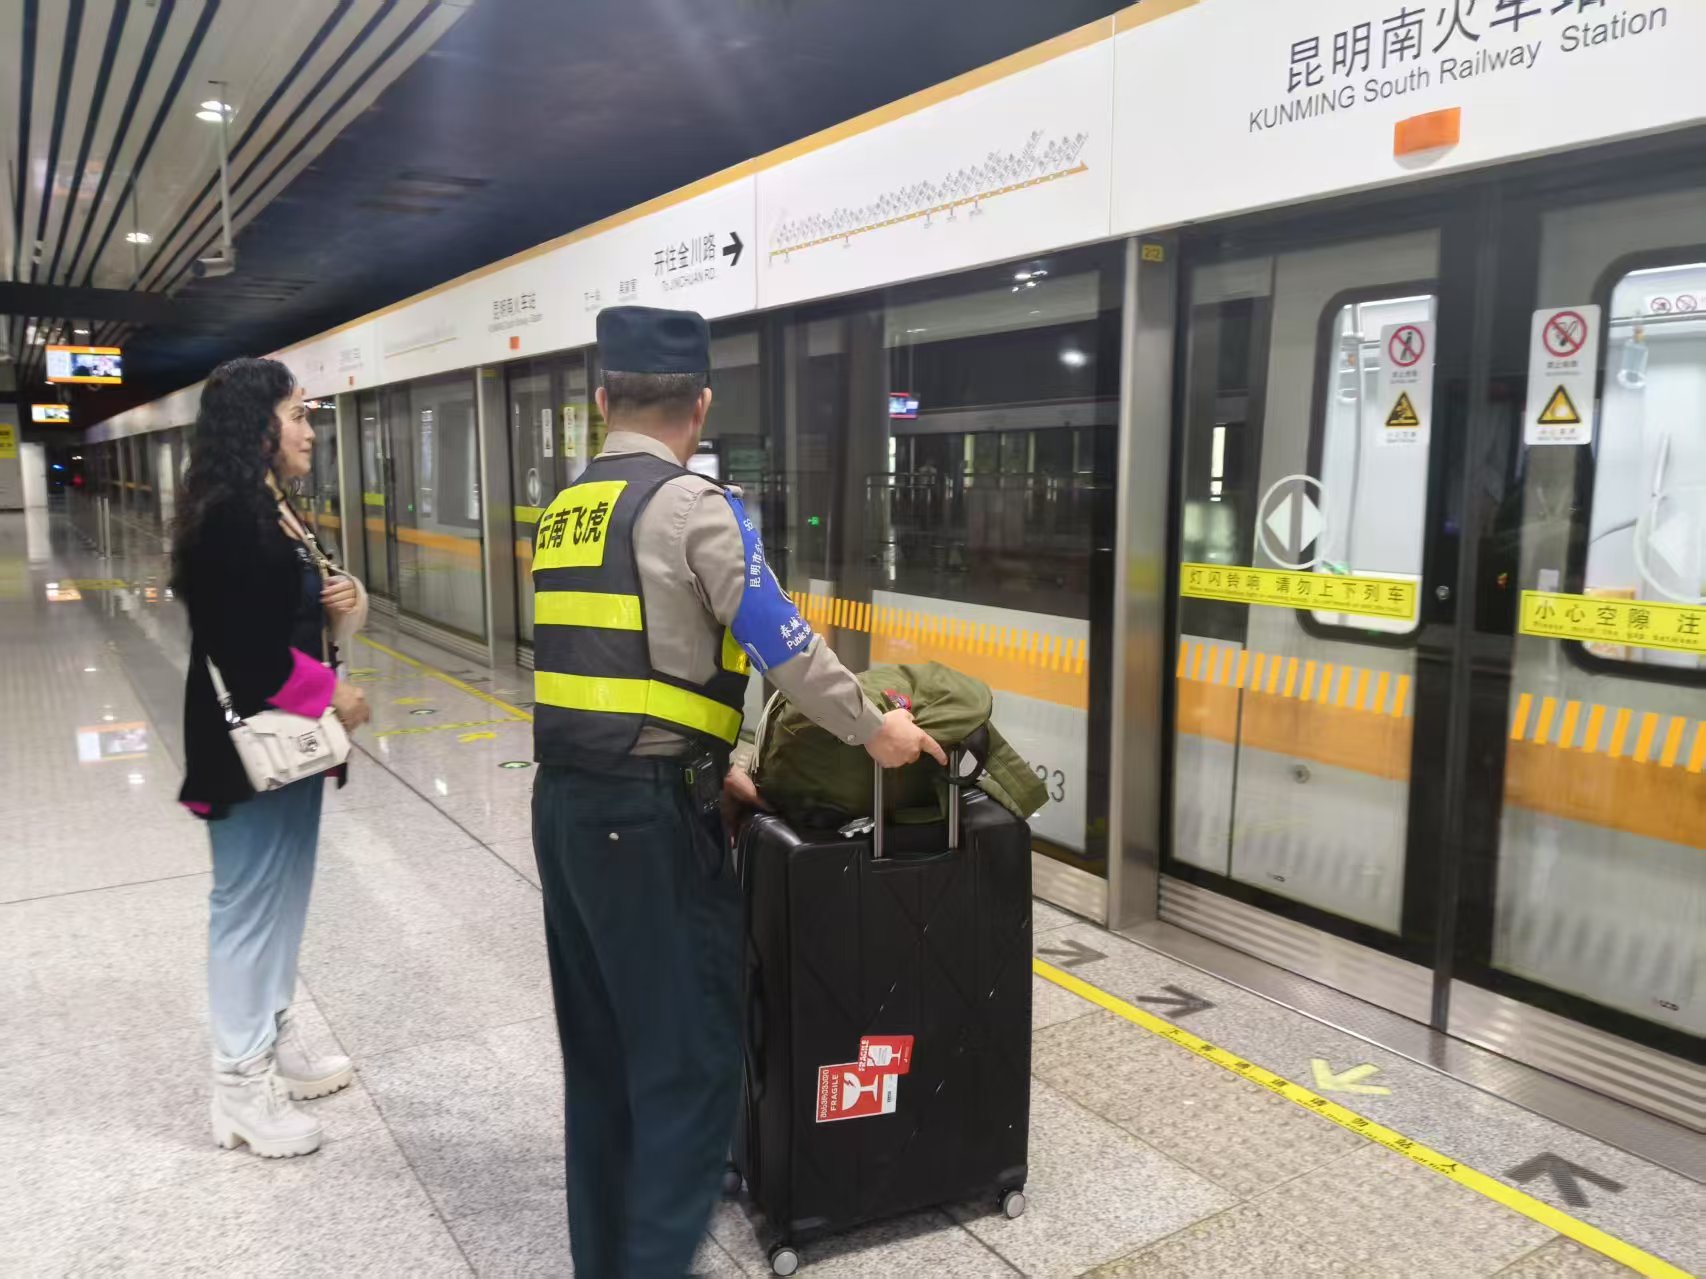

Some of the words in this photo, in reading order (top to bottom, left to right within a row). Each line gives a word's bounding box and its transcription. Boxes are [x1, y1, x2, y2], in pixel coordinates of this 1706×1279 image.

[1287, 0, 1605, 93] 昆明南火车
[1249, 85, 1355, 132] KUNMING
[1364, 66, 1430, 102] South
[1440, 40, 1541, 84] Railway
[1560, 7, 1667, 52] Station
[538, 501, 609, 550] 云南飞虎
[1275, 576, 1405, 604] 请勿上下列车
[780, 613, 802, 639] 春城
[1535, 599, 1650, 630] 小心空隙
[785, 630, 807, 650] Public
[831, 1073, 839, 1111] FRAGILE
